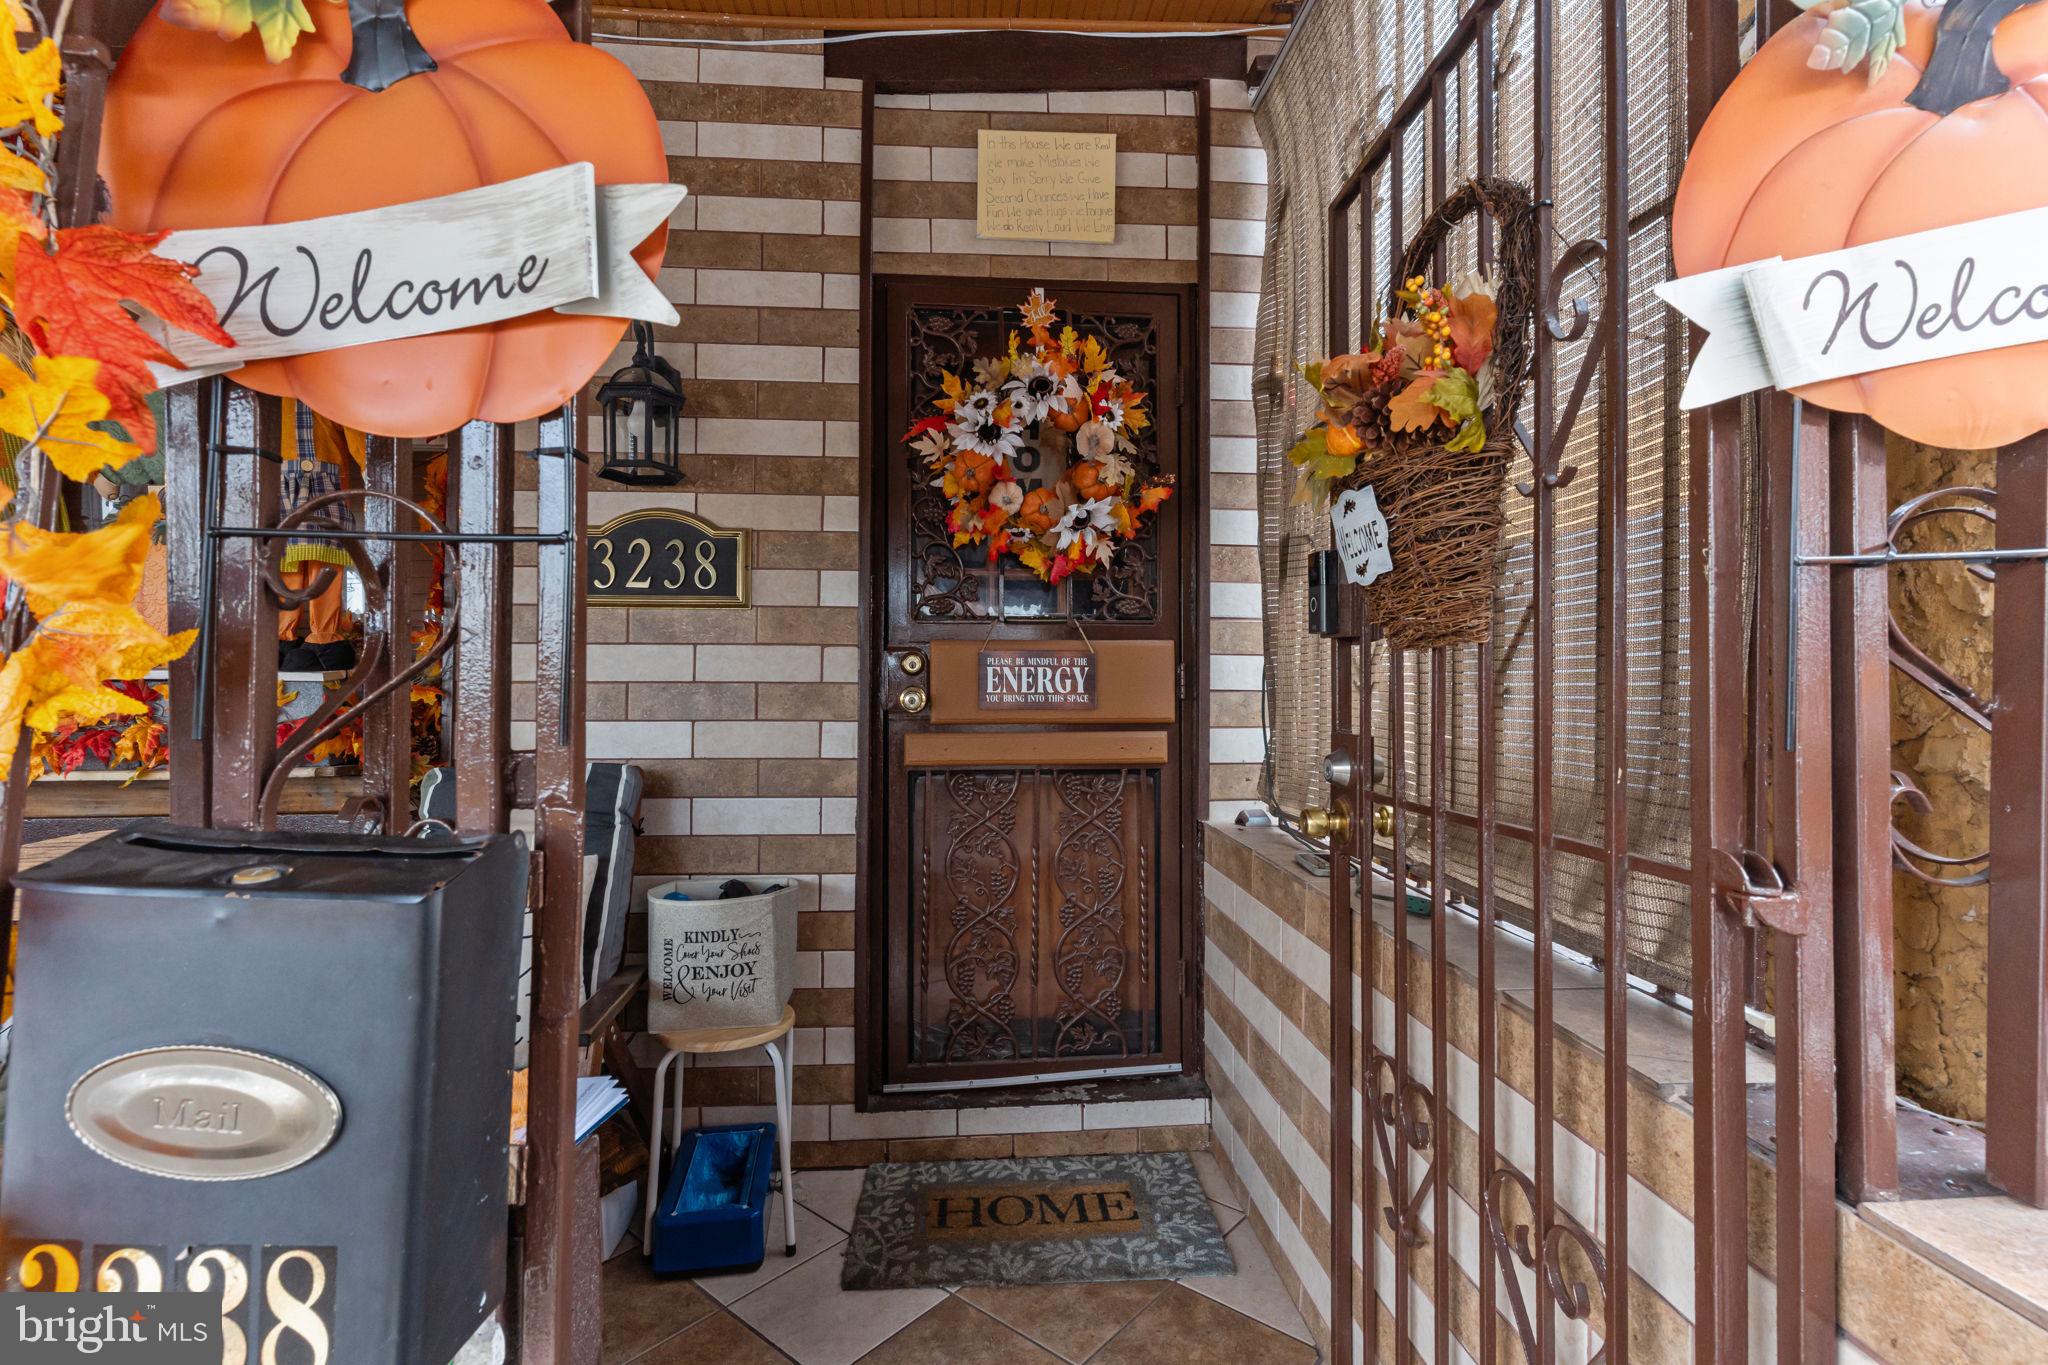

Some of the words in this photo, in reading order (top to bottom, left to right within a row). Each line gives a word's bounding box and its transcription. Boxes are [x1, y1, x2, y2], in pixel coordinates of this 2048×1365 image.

[986, 137, 996, 150] In
[1019, 136, 1051, 150] House
[1055, 137, 1071, 150] We
[1074, 141, 1091, 150] are
[987, 155, 1001, 168] We
[1007, 157, 1034, 168] make
[986, 169, 1007, 186] Say
[1029, 170, 1059, 189] Sorry
[1077, 171, 1102, 184] Give
[985, 187, 1024, 204] Second
[986, 204, 1005, 218] Fun
[1007, 204, 1022, 218] We
[1047, 219, 1072, 232] Loud
[190, 245, 550, 338] Welcome
[1337, 519, 1383, 562] WELCOME
[593, 538, 717, 590] 3238
[987, 657, 1013, 665] PLEASE
[1015, 657, 1025, 665] BE
[1027, 657, 1058, 665] MINDFUL
[1061, 657, 1071, 665] OF
[1074, 657, 1088, 665] THE
[986, 666, 1089, 693] ENERGY
[985, 694, 1000, 703] YOU
[1003, 694, 1025, 703] BRING
[1027, 694, 1045, 703] INTO
[1048, 694, 1065, 703] THIS
[1067, 694, 1089, 703] SPACE
[684, 928, 740, 944] KINDLY
[676, 943, 699, 963] Cover
[701, 944, 725, 963] Your
[727, 941, 762, 961] Shoes
[662, 938, 673, 1002] WELCOME
[673, 964, 697, 1005] &
[691, 960, 758, 981] ENJOY
[701, 982, 729, 1002] Your
[731, 977, 763, 1002] Visit
[152, 1096, 244, 1135] Mail
[931, 1189, 1140, 1230] HOME
